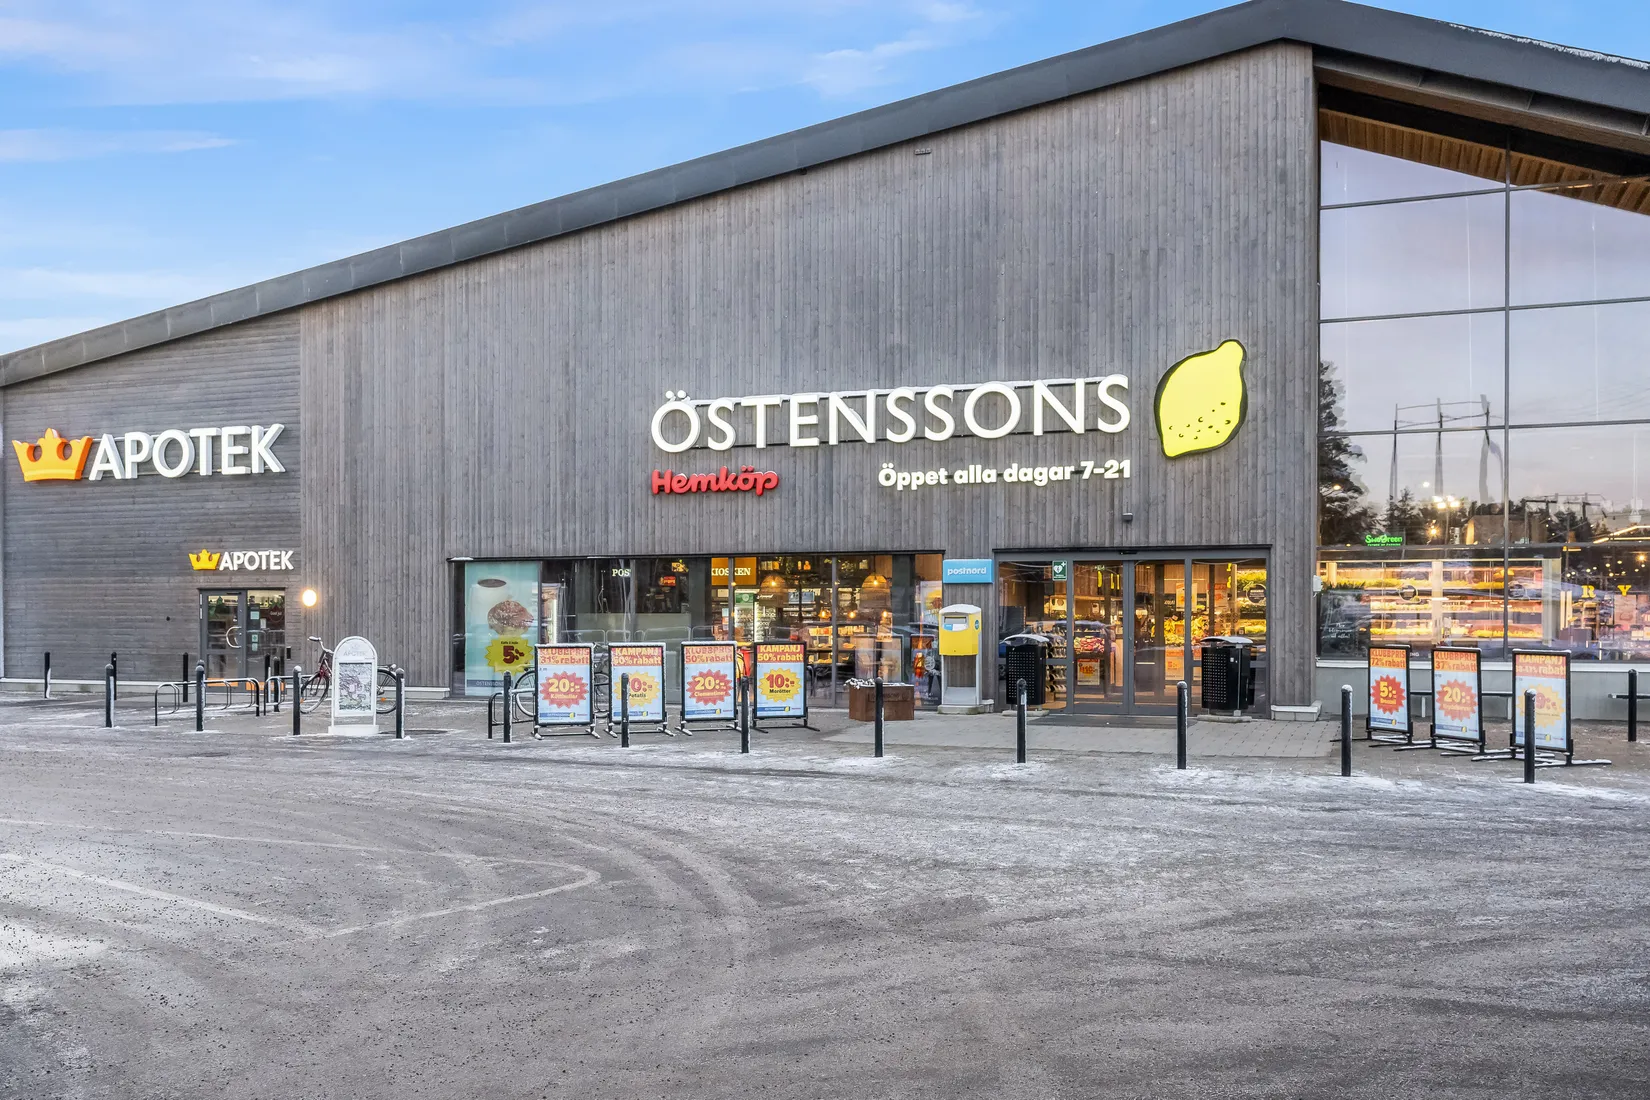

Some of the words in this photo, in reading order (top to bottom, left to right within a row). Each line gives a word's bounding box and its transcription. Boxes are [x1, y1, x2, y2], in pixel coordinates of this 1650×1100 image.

[650, 374, 1131, 453] ÖSTENSSONS
[89, 423, 286, 481] APOTEK
[651, 465, 779, 496] Hemköp
[878, 462, 948, 491] Öppet
[954, 463, 997, 485] alla
[1003, 462, 1074, 487] dagar
[219, 549, 294, 571] APOTEK
[947, 566, 987, 576] postnord
[615, 647, 659, 656] KAMPANJ
[760, 645, 801, 653] KAMPANJ
[1371, 649, 1406, 658] KLUBBPRIS
[560, 656, 589, 664] rabatt
[633, 656, 662, 665] rabatt
[685, 655, 705, 663] 50%
[757, 653, 776, 661] 50%
[777, 653, 804, 661] rabatt
[1435, 651, 1477, 661] KLUBBPRIS
[1519, 655, 1563, 665] KAMPANJ
[1371, 657, 1384, 666] 72%
[1385, 659, 1406, 668] rabatt
[1453, 662, 1477, 672] rabatt
[1539, 665, 1566, 675] rabatt
